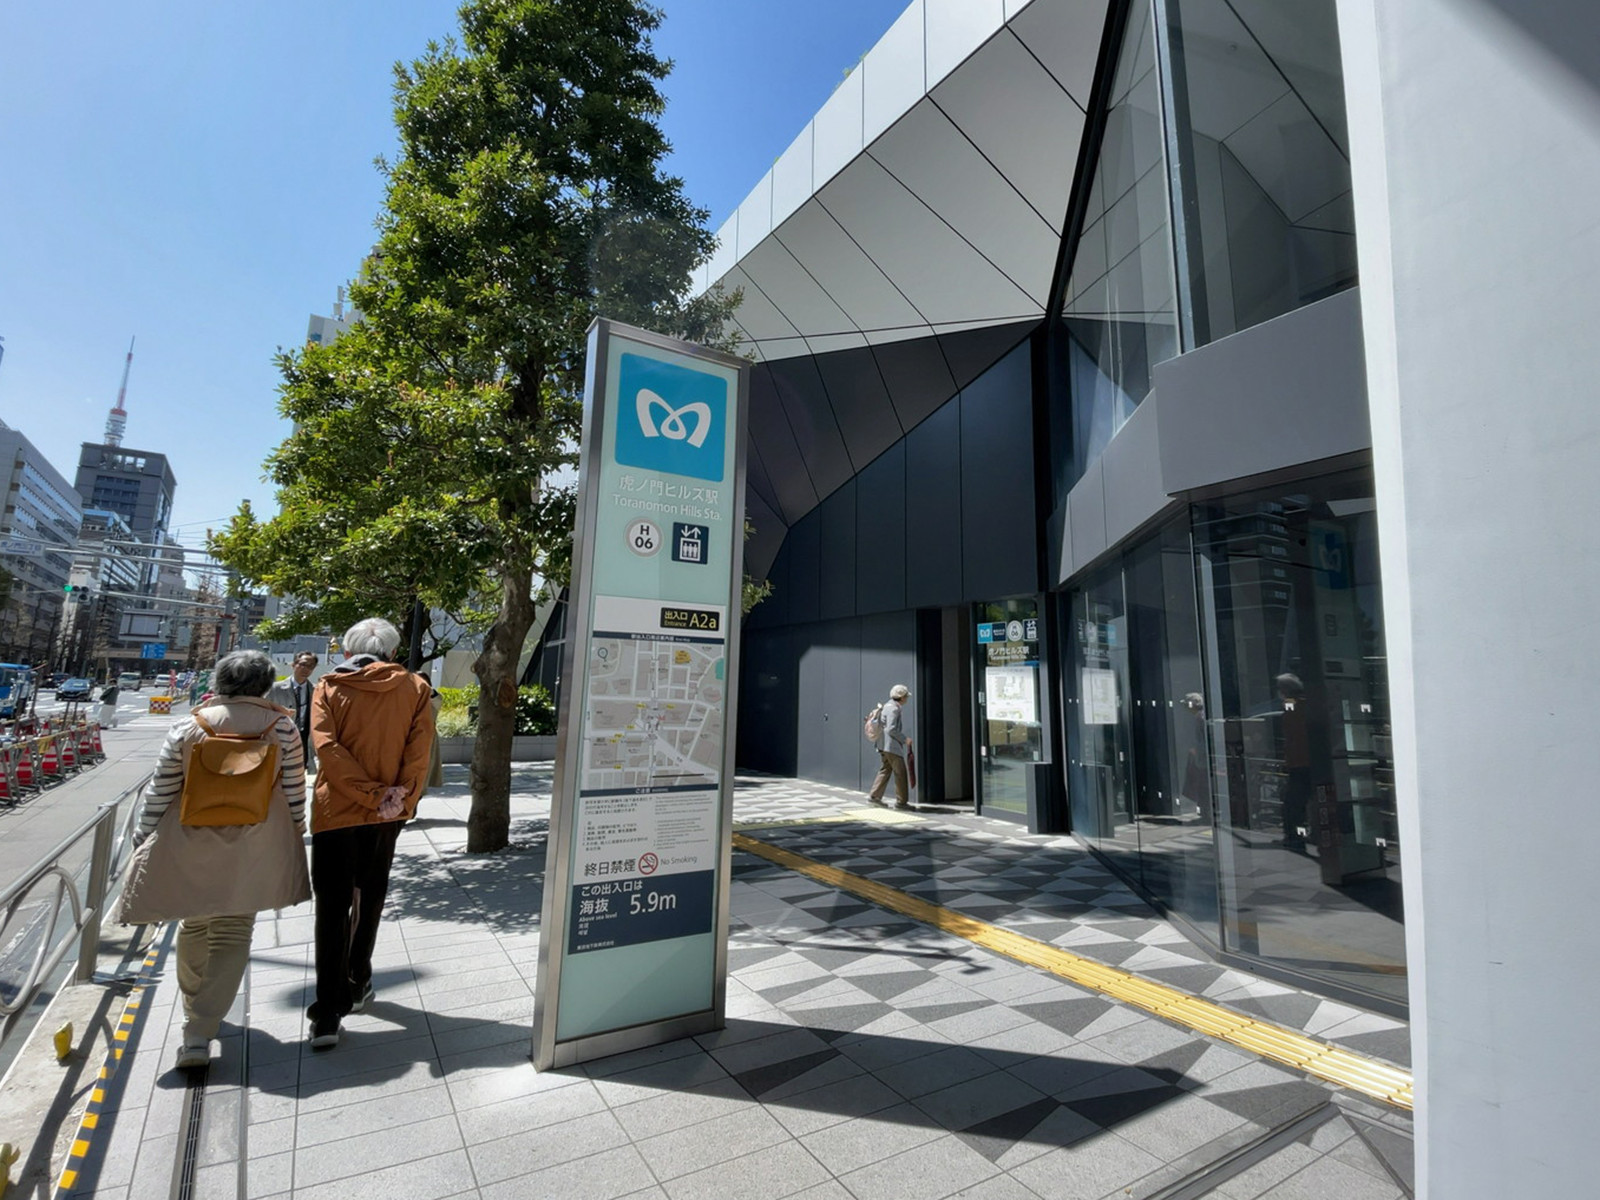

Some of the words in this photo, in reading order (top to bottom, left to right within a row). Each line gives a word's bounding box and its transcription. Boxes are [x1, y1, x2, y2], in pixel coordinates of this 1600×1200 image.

[619, 475, 719, 504] 虎ノ門ヒルズ駅
[613, 494, 678, 514] Toranomon
[680, 504, 701, 518] Hills
[704, 508, 722, 520] Sta.
[640, 525, 650, 536] H
[635, 537, 653, 549] 06
[664, 611, 688, 620] 出入口
[689, 613, 716, 629] A2a
[584, 858, 636, 877] 終日禁煙
[660, 858, 669, 866] No
[671, 855, 698, 865] Smoking
[581, 880, 643, 896] この出入口は
[579, 898, 609, 915] 海抜
[630, 891, 676, 915] 5.9m
[579, 915, 595, 923] Above
